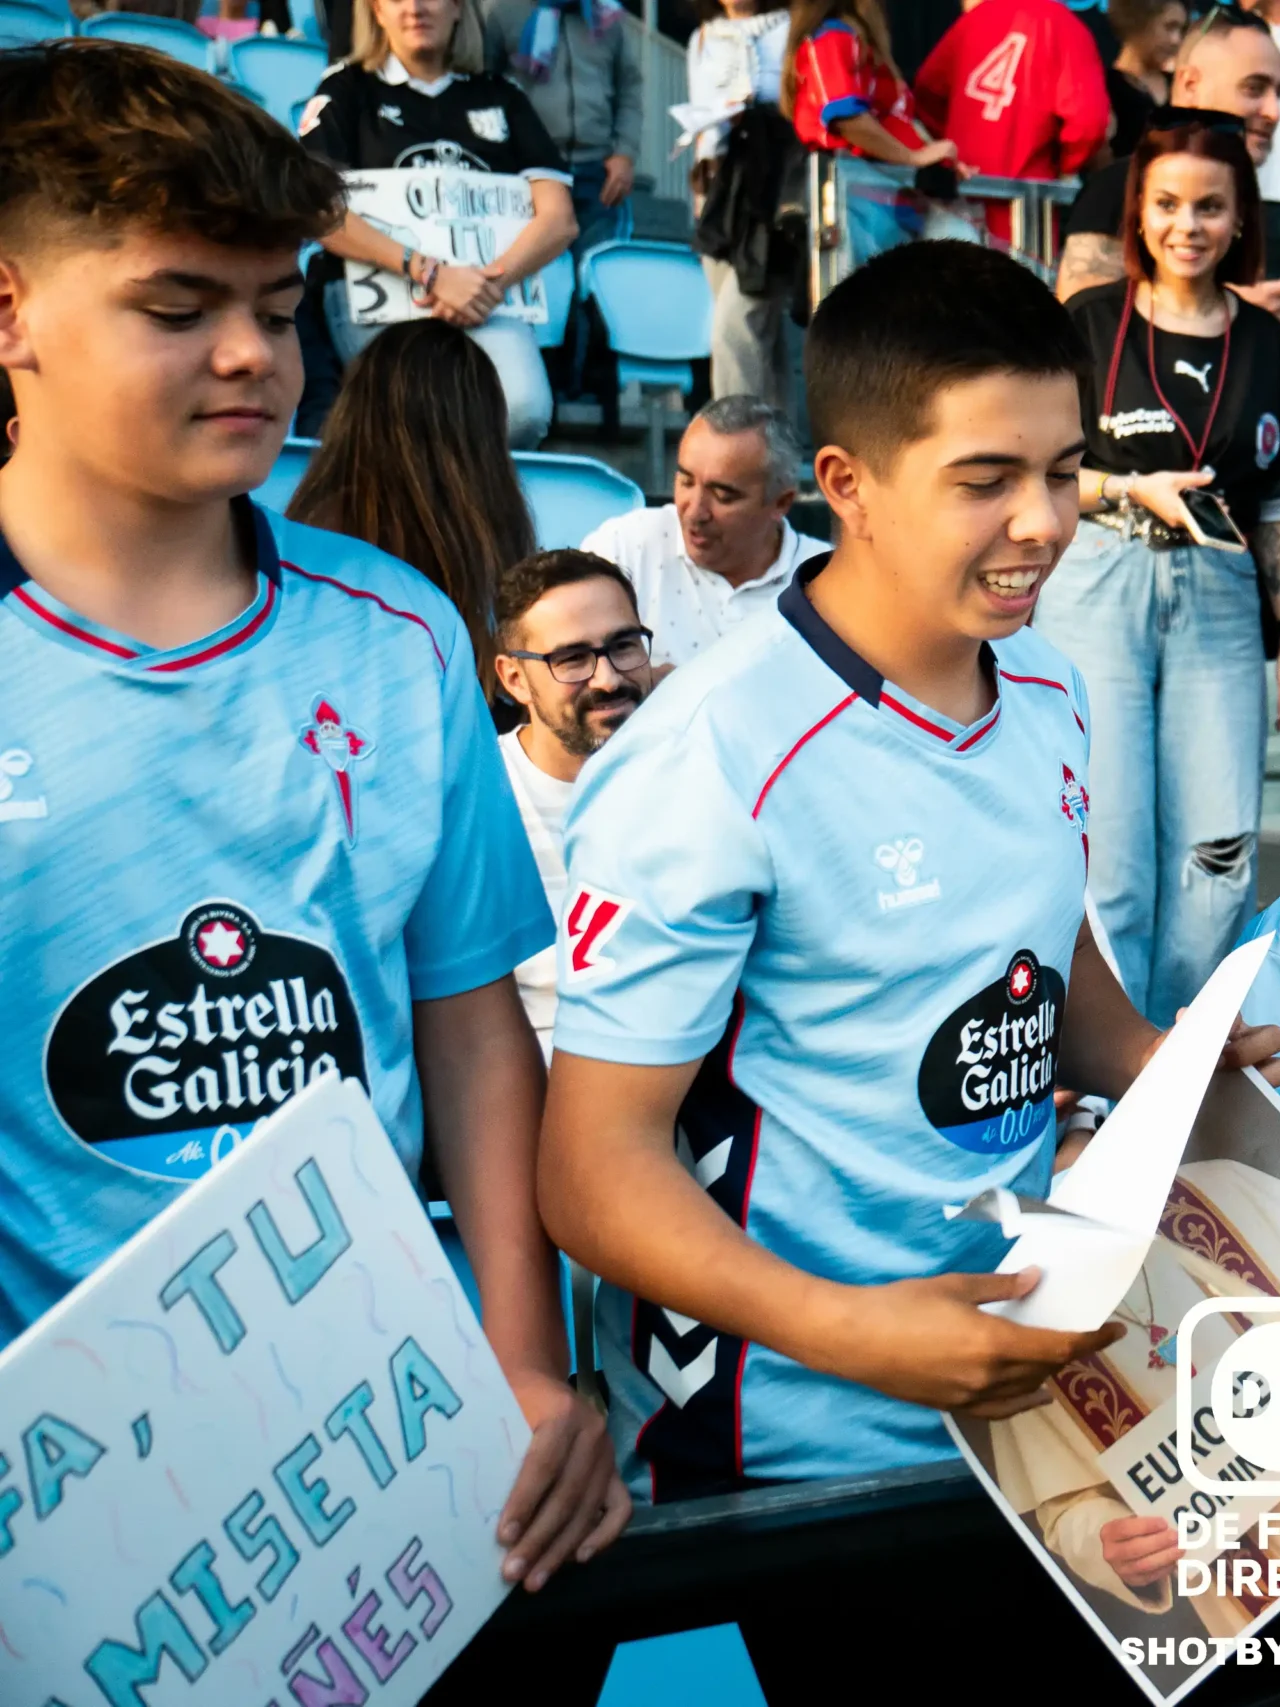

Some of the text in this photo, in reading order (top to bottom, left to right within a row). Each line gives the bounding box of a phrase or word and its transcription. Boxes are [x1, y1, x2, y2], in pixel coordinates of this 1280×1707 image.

[964, 31, 1028, 121] 4
[106, 976, 339, 1055] Estrella
[955, 999, 1056, 1065] Estrella
[961, 1046, 1053, 1112] Galicia
[158, 1156, 353, 1355] TU
[44, 1334, 464, 1707] MISETA
[264, 1534, 455, 1707] ÑÉS
